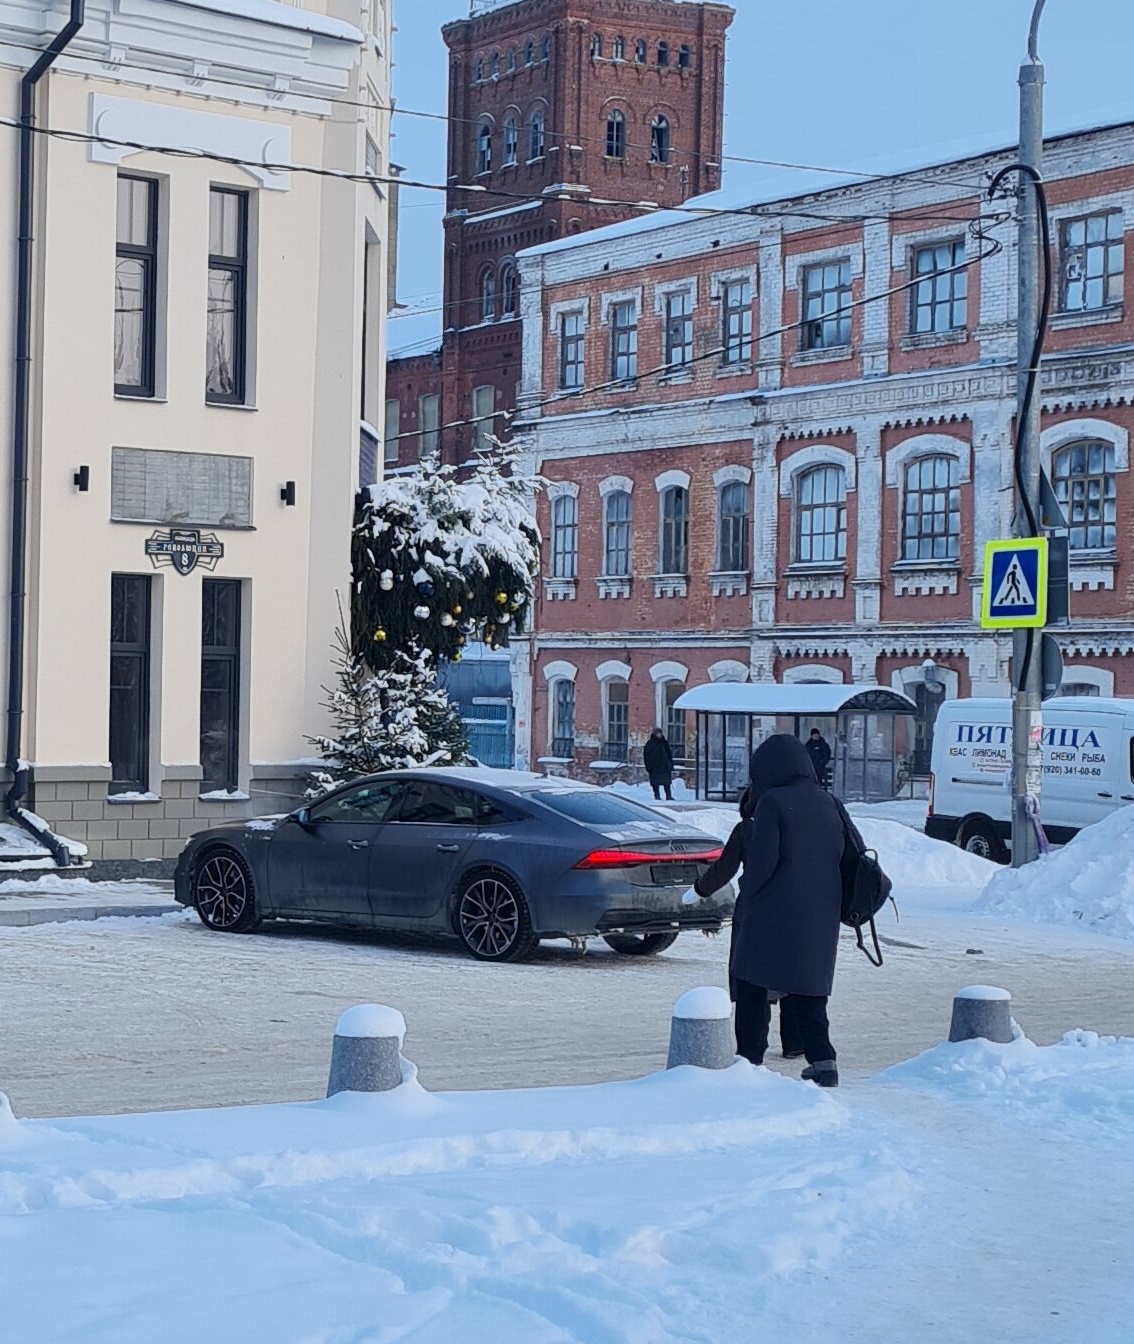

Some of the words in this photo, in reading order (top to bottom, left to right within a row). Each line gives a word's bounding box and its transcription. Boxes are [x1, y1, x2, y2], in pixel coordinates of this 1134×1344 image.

[181, 552, 189, 566] 8
[956, 724, 1102, 751] ПЯТИЦА
[1050, 751, 1076, 762] СНЕКИ
[1081, 752, 1106, 763] РЫБА
